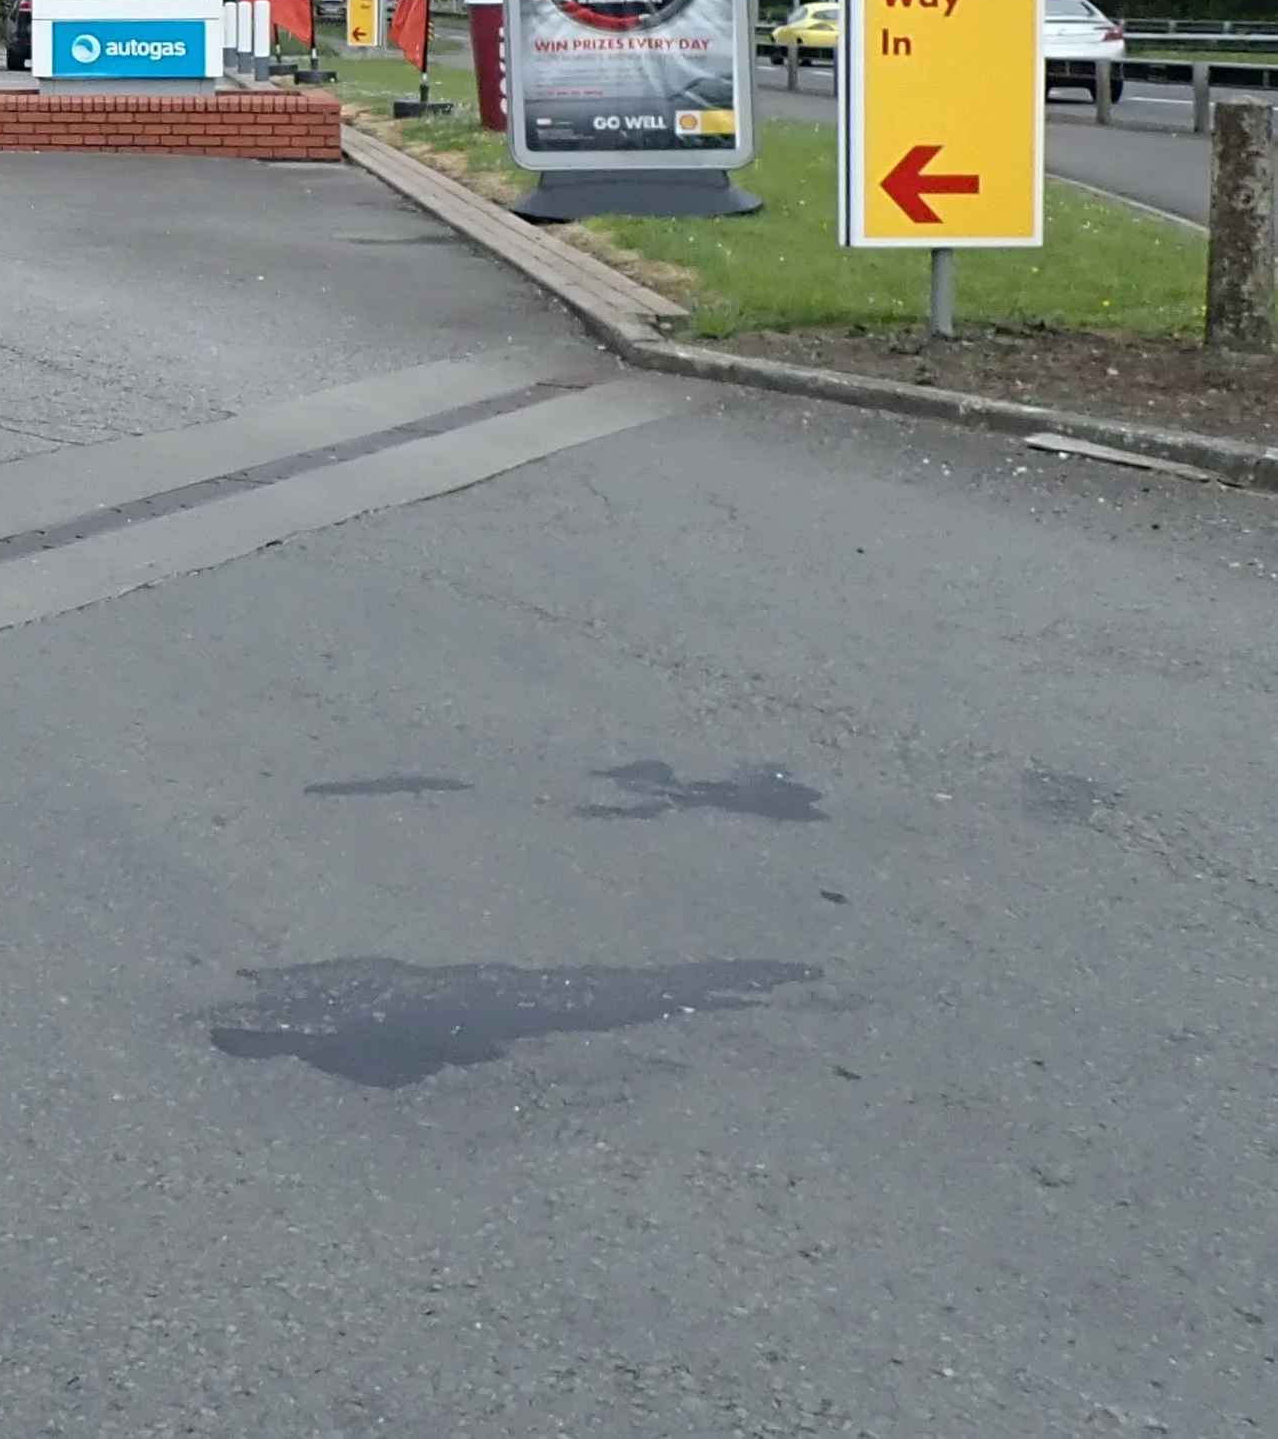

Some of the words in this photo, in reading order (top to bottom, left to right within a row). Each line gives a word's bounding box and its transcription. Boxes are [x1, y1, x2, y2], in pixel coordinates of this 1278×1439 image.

[106, 39, 186, 60] autogas
[535, 41, 567, 52] WIN
[573, 39, 624, 50] PRIZES
[629, 38, 673, 50] EVERY
[679, 39, 711, 50] DAY
[881, 28, 912, 56] In
[593, 117, 620, 130] GO
[625, 117, 666, 129] WELL
